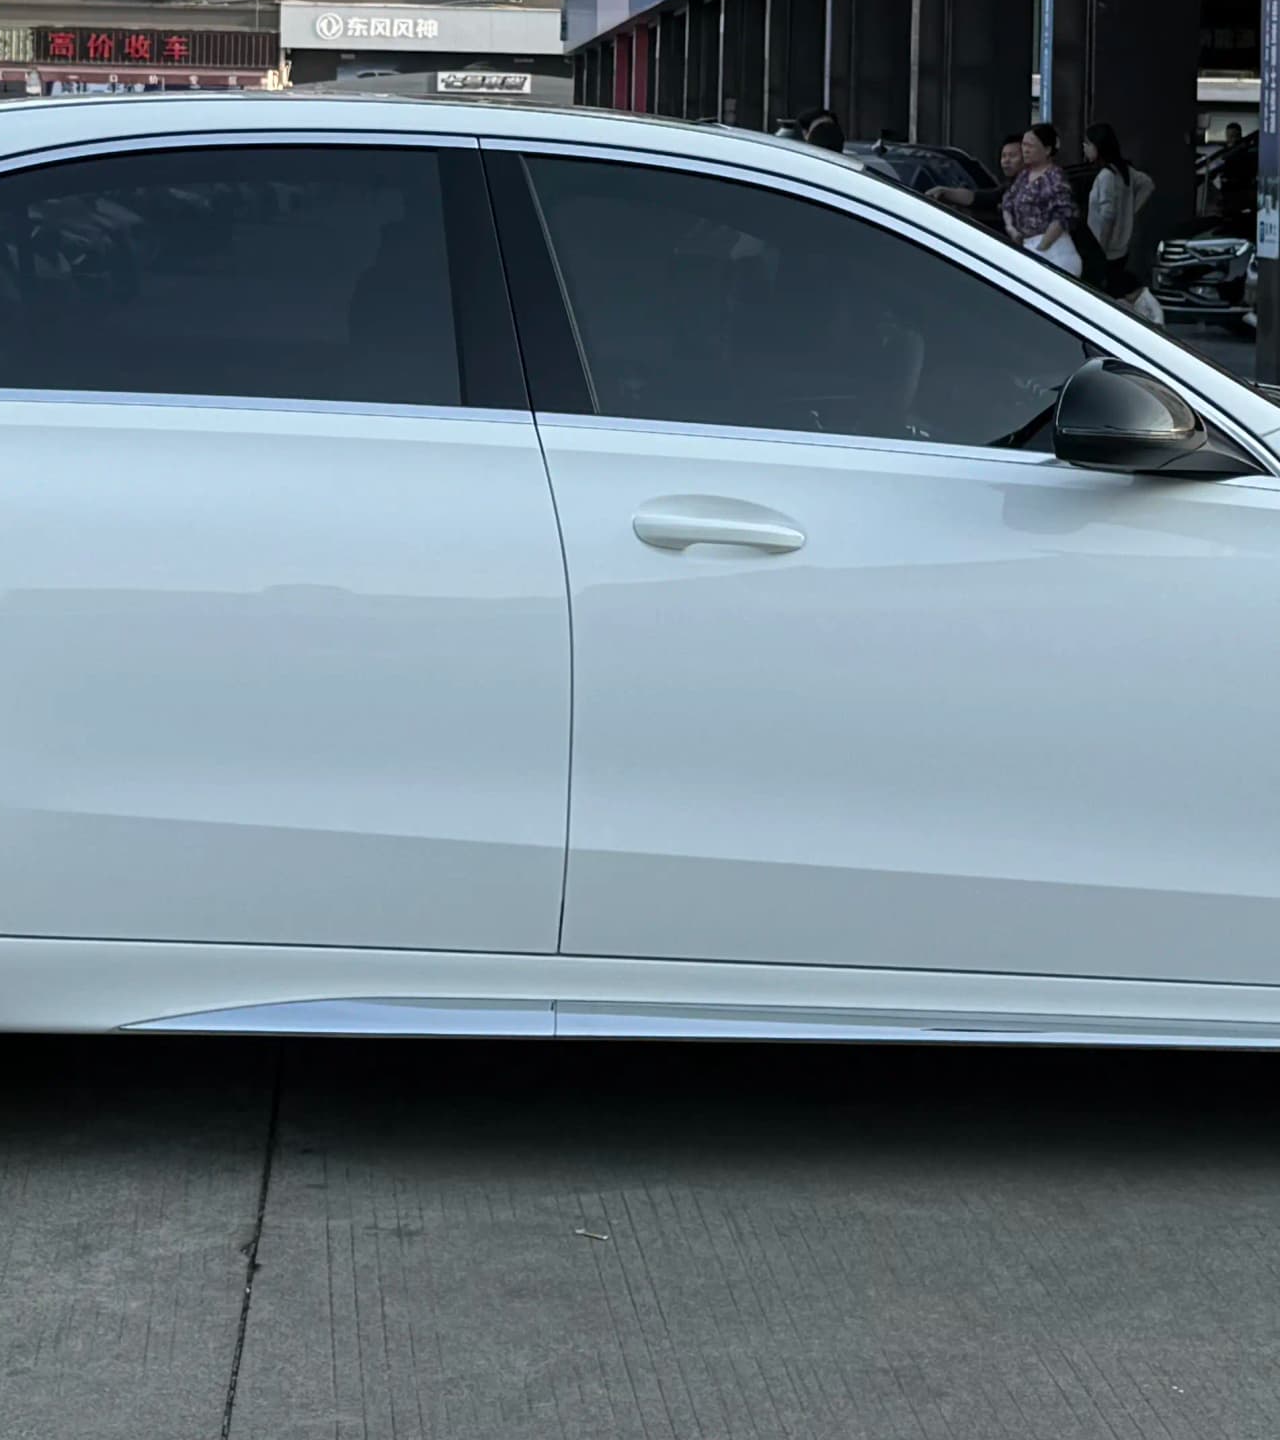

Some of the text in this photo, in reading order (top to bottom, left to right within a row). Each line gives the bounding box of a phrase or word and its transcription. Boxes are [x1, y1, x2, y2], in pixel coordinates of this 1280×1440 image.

[347, 17, 440, 39] 东风风神
[48, 33, 191, 59] 高价收车
